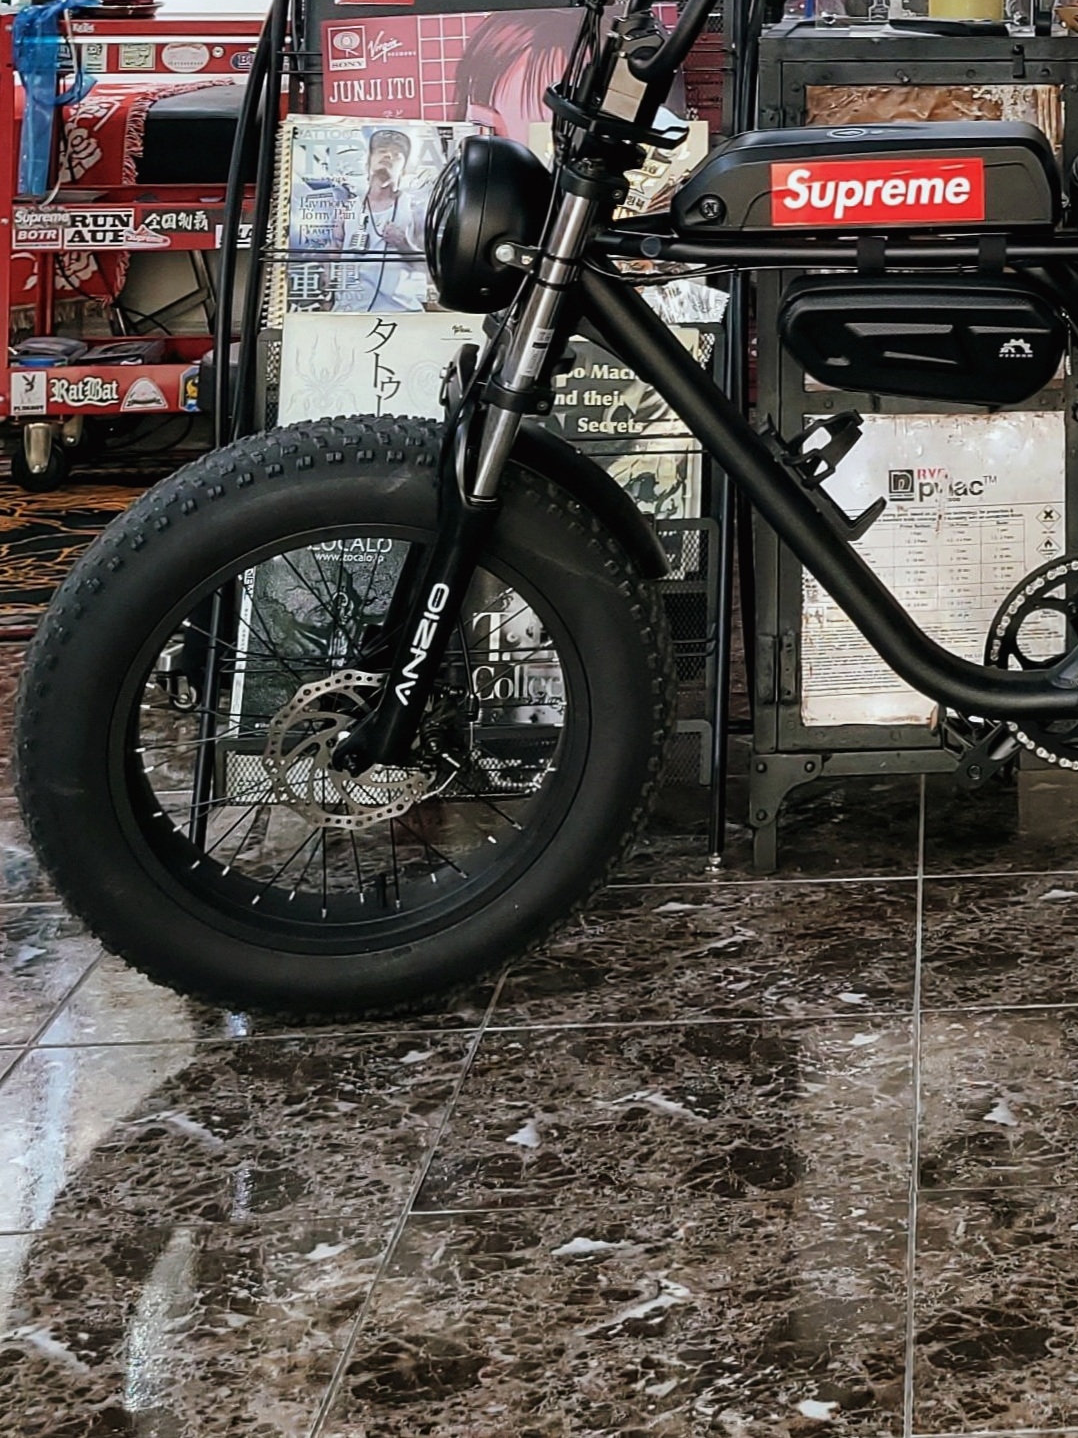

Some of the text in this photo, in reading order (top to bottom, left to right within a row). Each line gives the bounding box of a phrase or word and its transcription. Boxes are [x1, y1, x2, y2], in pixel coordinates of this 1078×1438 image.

[367, 30, 403, 63] Virgin
[331, 61, 363, 69] SONY
[329, 77, 416, 103] JUNJI ITO
[783, 168, 971, 219] Supreme
[69, 214, 133, 228] RUN
[17, 229, 58, 240] BOTR
[50, 378, 120, 405] RatBat
[577, 417, 645, 434] Secrets
[307, 537, 393, 553] OCALO
[395, 582, 450, 706] ANZIO
